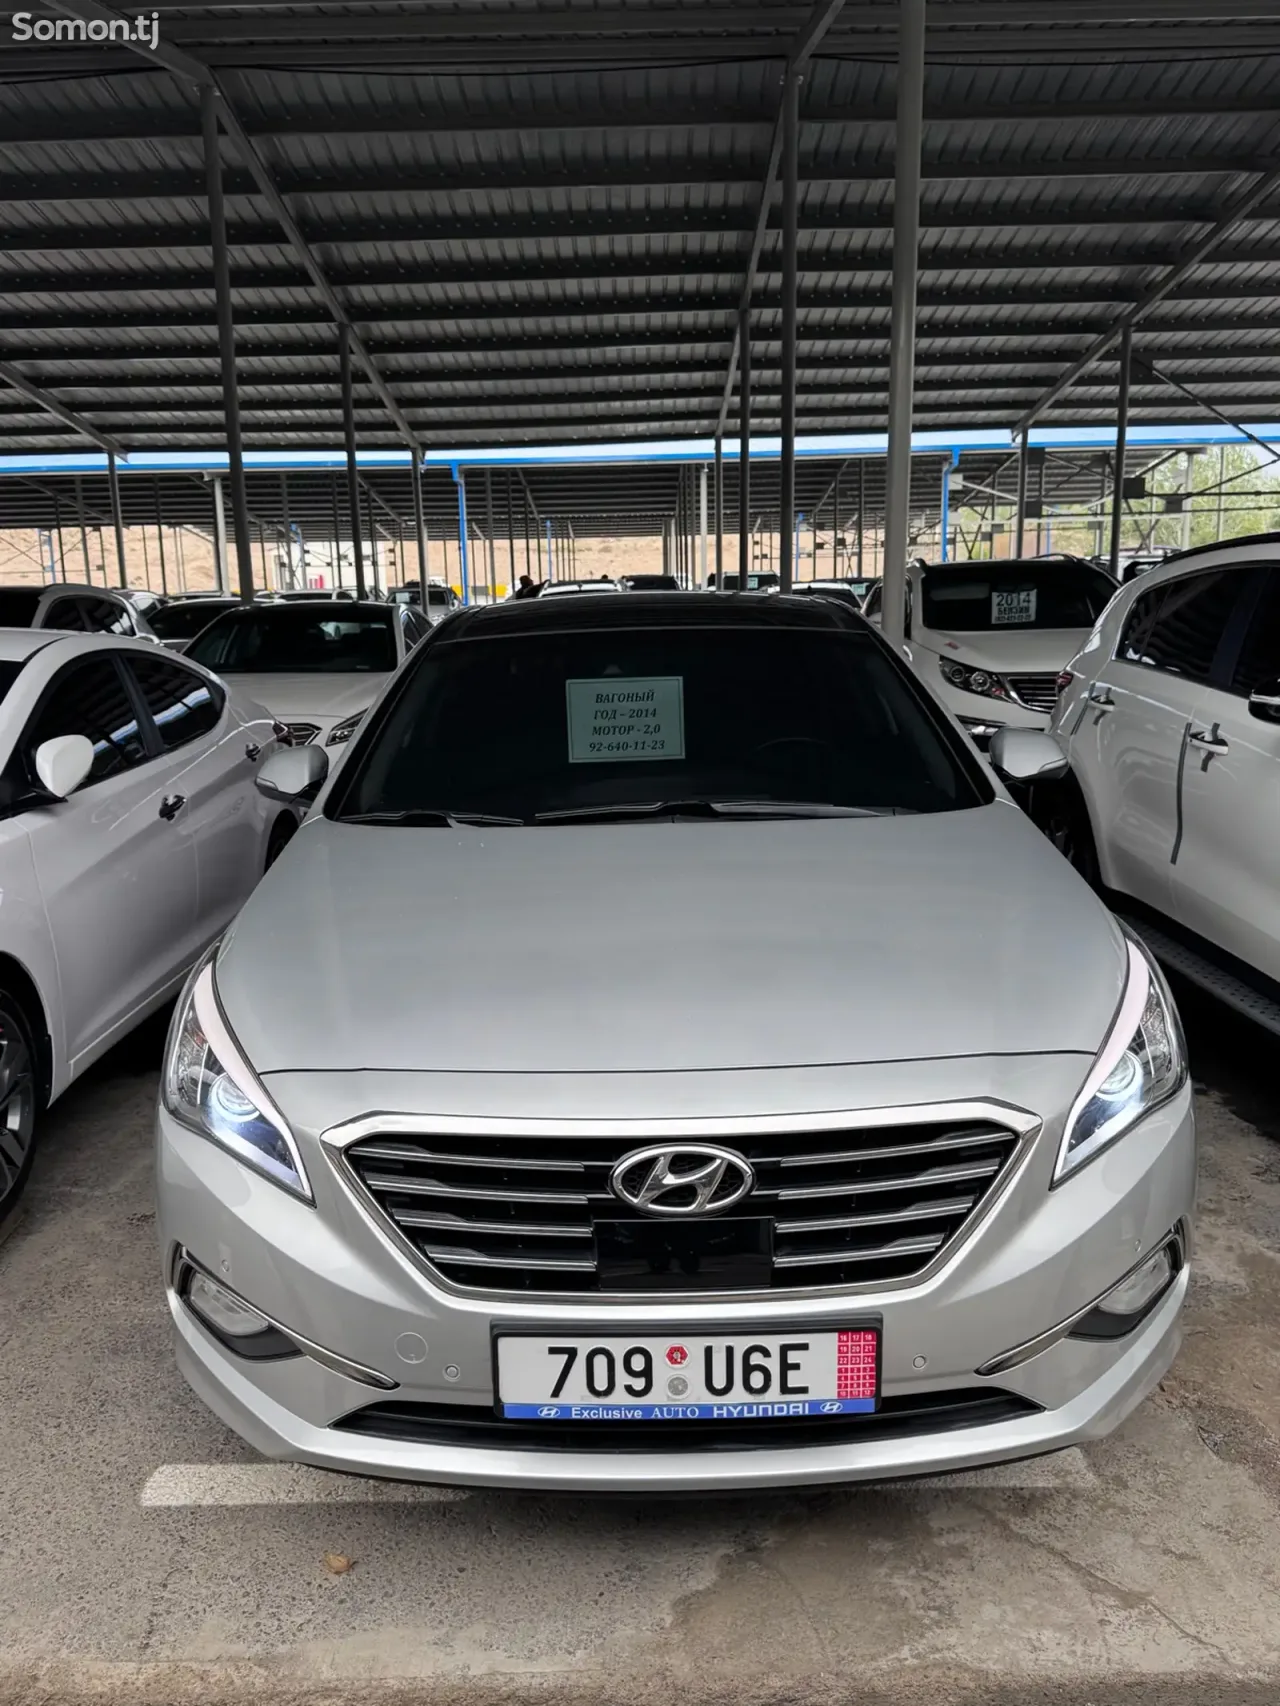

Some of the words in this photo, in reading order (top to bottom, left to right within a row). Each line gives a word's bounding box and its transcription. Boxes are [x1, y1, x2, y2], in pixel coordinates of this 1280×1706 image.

[996, 592, 1031, 607] 2014
[595, 689, 655, 704] ВАГОНЫЙ
[594, 709, 617, 721] ГОД
[628, 708, 657, 719] 2014
[592, 725, 634, 736] МОТОР
[643, 724, 661, 736] 2,0
[589, 740, 665, 753] 92-640-11-23
[547, 1344, 653, 1399] 709
[704, 1342, 810, 1397] U6E
[571, 1407, 642, 1419] Exclusive
[651, 1406, 699, 1418] AUTO
[713, 1402, 809, 1418] HYUNDAI
